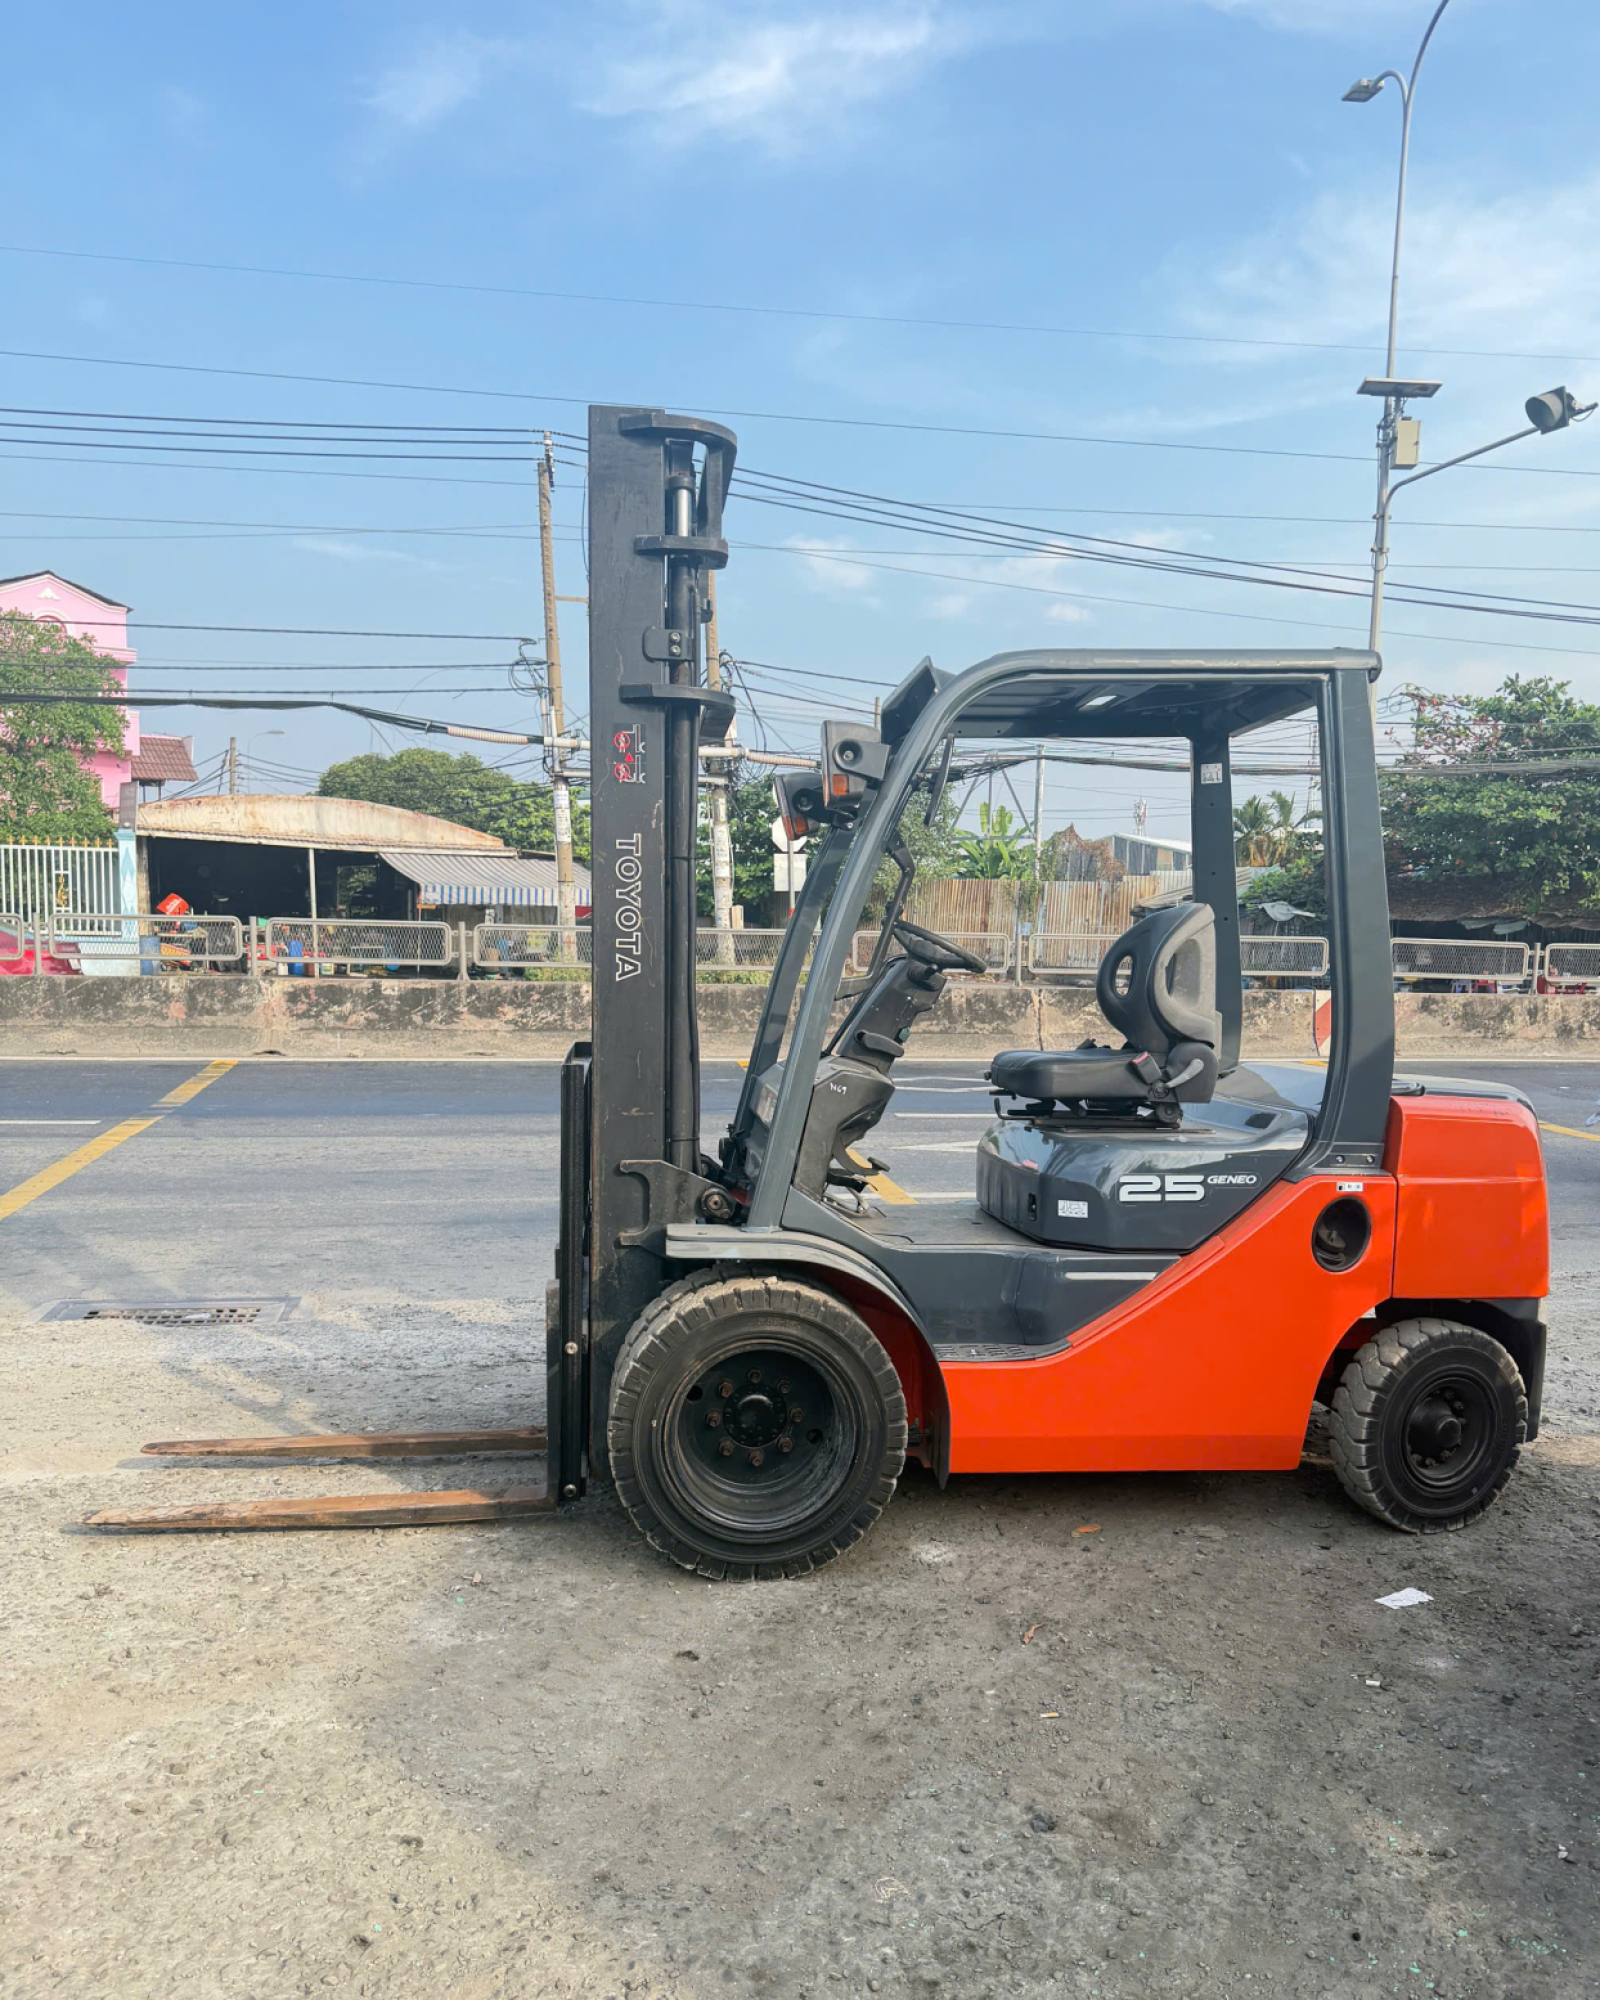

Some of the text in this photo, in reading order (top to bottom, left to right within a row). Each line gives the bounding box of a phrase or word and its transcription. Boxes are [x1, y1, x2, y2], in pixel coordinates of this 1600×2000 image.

[615, 832, 642, 982] TOYOTA
[1119, 1174, 1257, 1202] 25 GENEO
